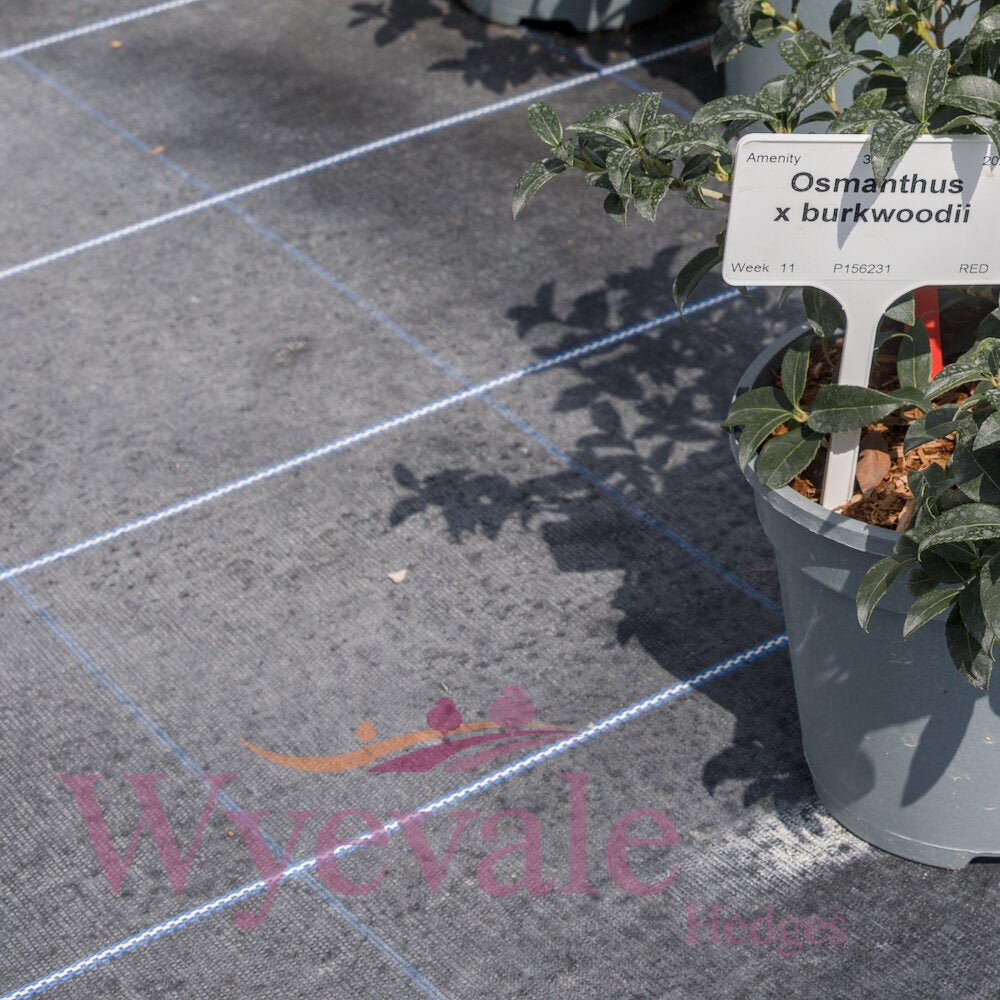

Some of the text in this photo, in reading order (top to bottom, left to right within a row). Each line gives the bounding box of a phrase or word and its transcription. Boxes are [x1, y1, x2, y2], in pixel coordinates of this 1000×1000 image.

[746, 152, 802, 165] Amenity
[791, 172, 964, 194] Osmanthus
[773, 203, 971, 223] x burkwoodii
[731, 262, 795, 274] Week 11
[833, 263, 892, 274] P156231
[959, 264, 989, 274] RED
